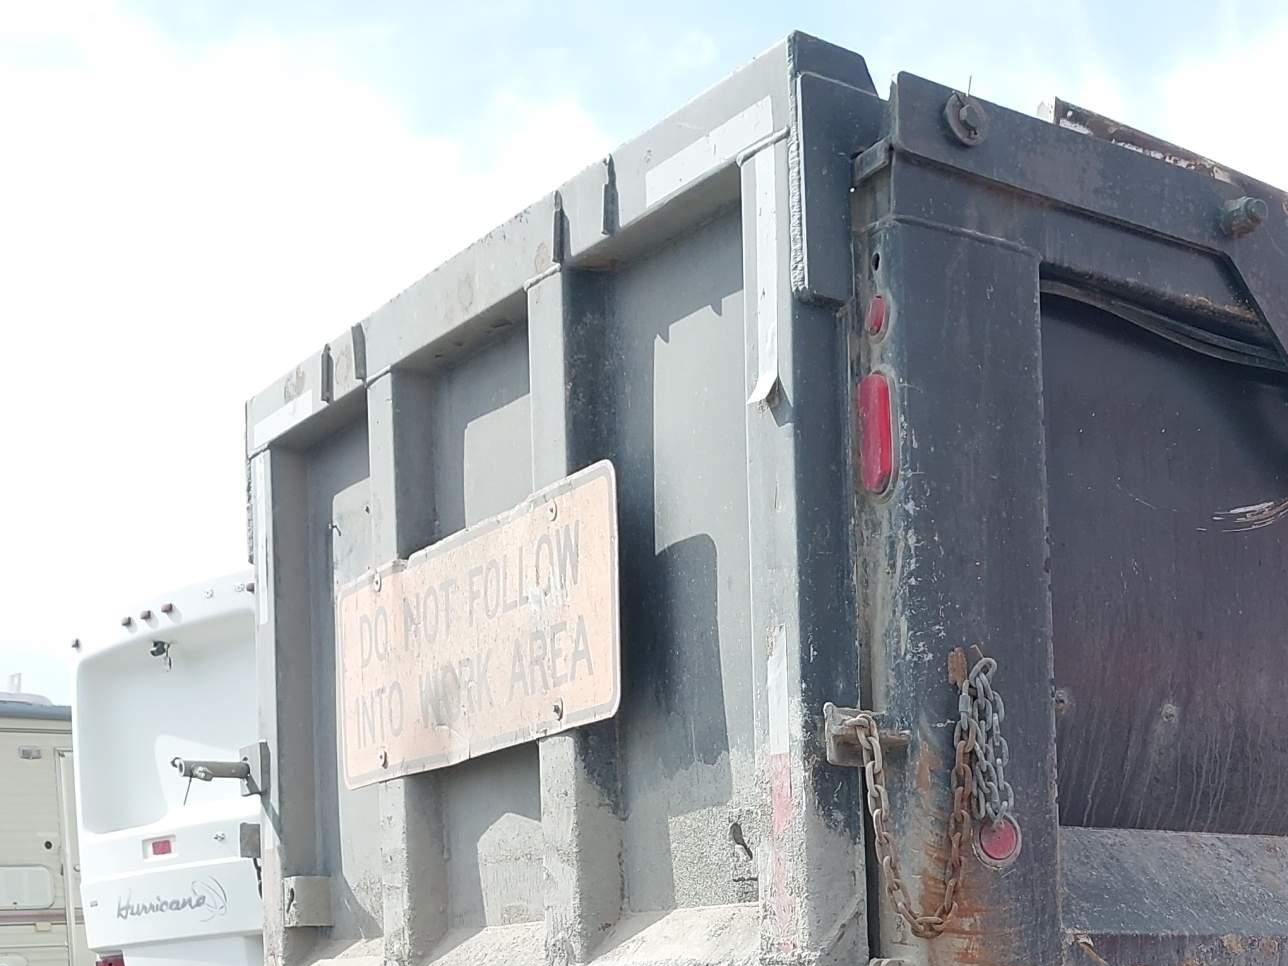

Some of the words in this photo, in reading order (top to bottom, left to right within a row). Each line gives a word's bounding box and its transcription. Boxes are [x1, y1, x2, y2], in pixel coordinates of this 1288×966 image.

[359, 606, 390, 669] DO
[404, 577, 455, 650] NOT
[467, 519, 580, 627] FOLLOW
[356, 681, 404, 750] INTO
[419, 653, 494, 730] WORK
[509, 613, 594, 698] AREA
[117, 887, 207, 920] Hurricane
